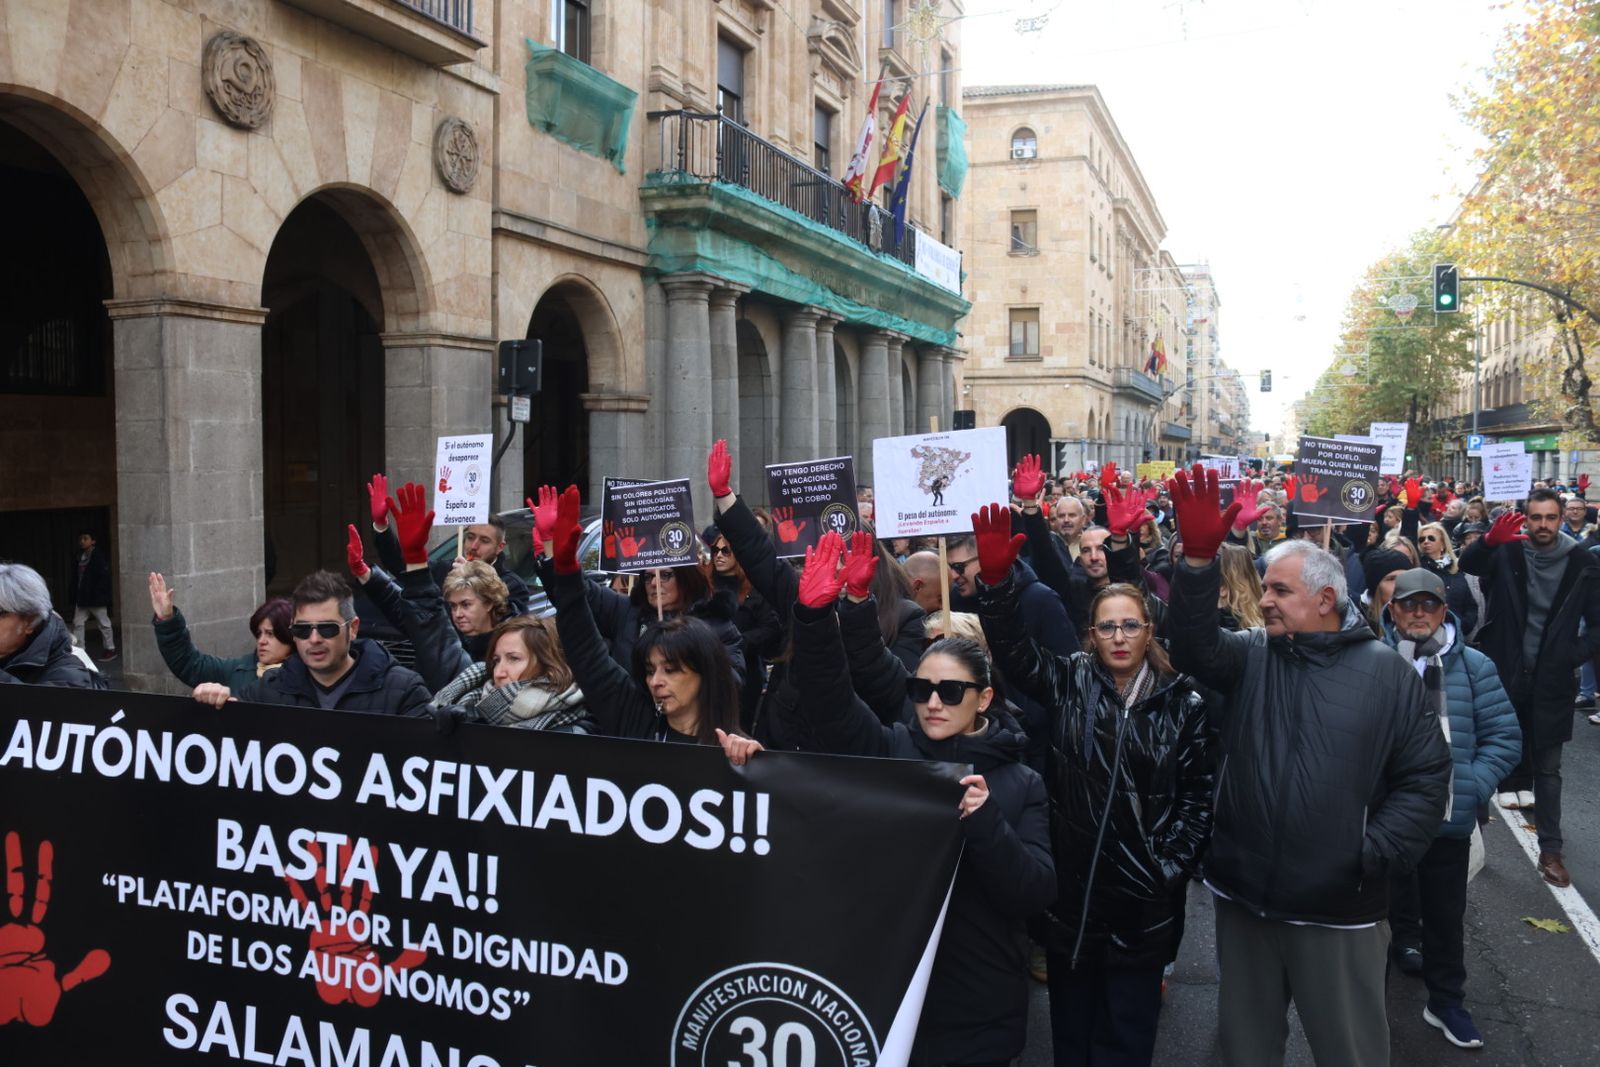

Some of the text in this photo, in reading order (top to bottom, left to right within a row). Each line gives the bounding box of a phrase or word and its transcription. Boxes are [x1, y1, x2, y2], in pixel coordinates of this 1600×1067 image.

[457, 440, 484, 449] autónomo
[1469, 436, 1481, 448] P
[1318, 442, 1342, 451] TENGO
[1344, 445, 1377, 455] PERMISO
[448, 453, 479, 462] desaparece
[1318, 451, 1361, 461] POR DUELO.
[783, 467, 809, 476] TENGO
[811, 462, 845, 472] DERECHO
[1302, 457, 1327, 466] MUERA
[1328, 461, 1351, 469] QUIEN
[1353, 463, 1378, 472] MUERA
[468, 472, 477, 482] 30
[1310, 467, 1366, 479] TRABAJO IGUAL
[804, 483, 837, 493] TRABAJO
[1350, 487, 1365, 499] 30
[623, 490, 652, 500] COLORES
[805, 494, 831, 503] COBRO
[445, 499, 468, 511] España
[444, 514, 476, 523] desvanece
[622, 511, 680, 524] SOLO AUTÓNOMOS
[830, 513, 846, 527] 30
[898, 512, 904, 520] El
[904, 512, 917, 521] peso
[918, 510, 927, 519] del
[668, 529, 683, 543] 30
[637, 549, 666, 558] PIDIENDO
[664, 555, 691, 563] TRABAJAR
[0, 709, 771, 855] AUTÓNOMOS ASFIXIADOS!!
[216, 818, 499, 914] BASTA YA!!
[102, 873, 629, 986] “PLATAFORMA POR LA DIGNIDAD
[187, 930, 531, 1021] DE LOS AUTÓNOMOS”
[682, 974, 808, 1052] MANIFESTACION
[727, 1016, 816, 1067] 30
